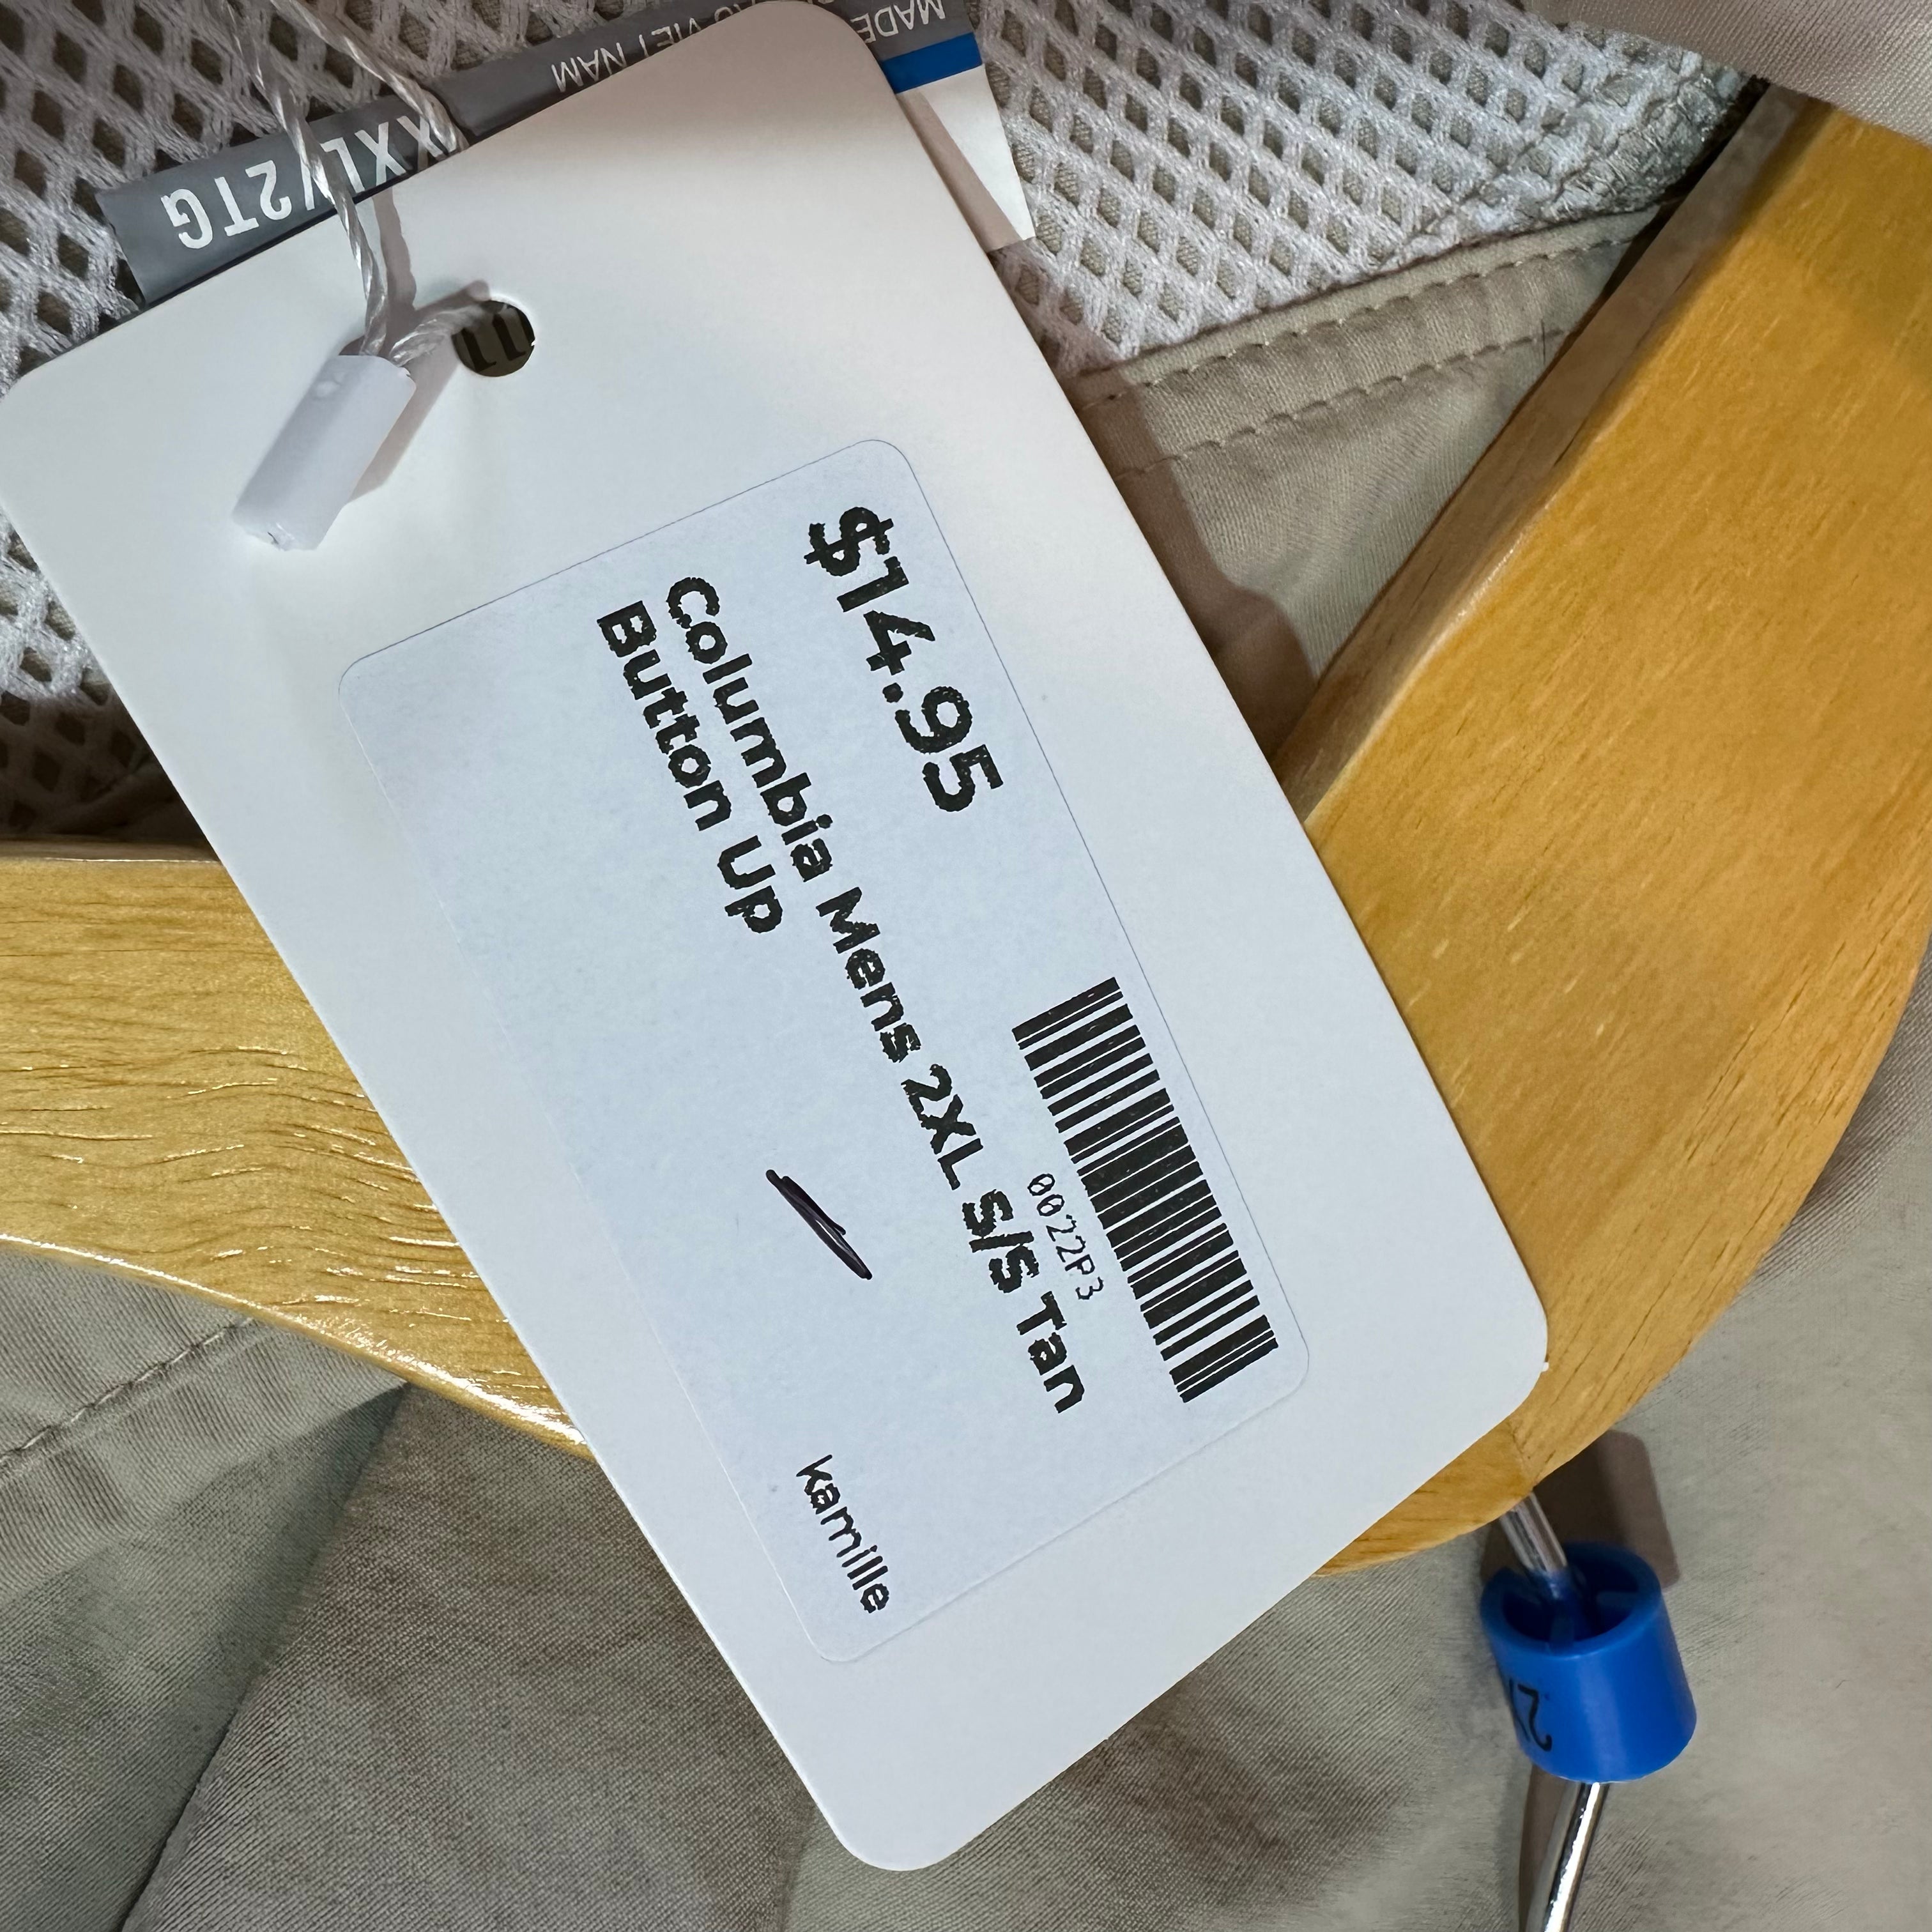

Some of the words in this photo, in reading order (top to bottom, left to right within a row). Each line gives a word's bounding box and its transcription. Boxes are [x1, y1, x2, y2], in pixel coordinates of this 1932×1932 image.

[551, 42, 627, 93] NAM
[851, 0, 946, 44] MADE
[804, 507, 1003, 812] $14.95
[597, 601, 732, 831] Button
[717, 835, 783, 933] Up
[666, 577, 832, 882] Columbia
[816, 887, 921, 1062] Mens
[901, 1064, 983, 1190] 2XL
[962, 1189, 1039, 1293] S/S
[1016, 1291, 1084, 1413] Tan
[1027, 1174, 1103, 1300] 0022P3
[796, 1455, 889, 1613] kamille
